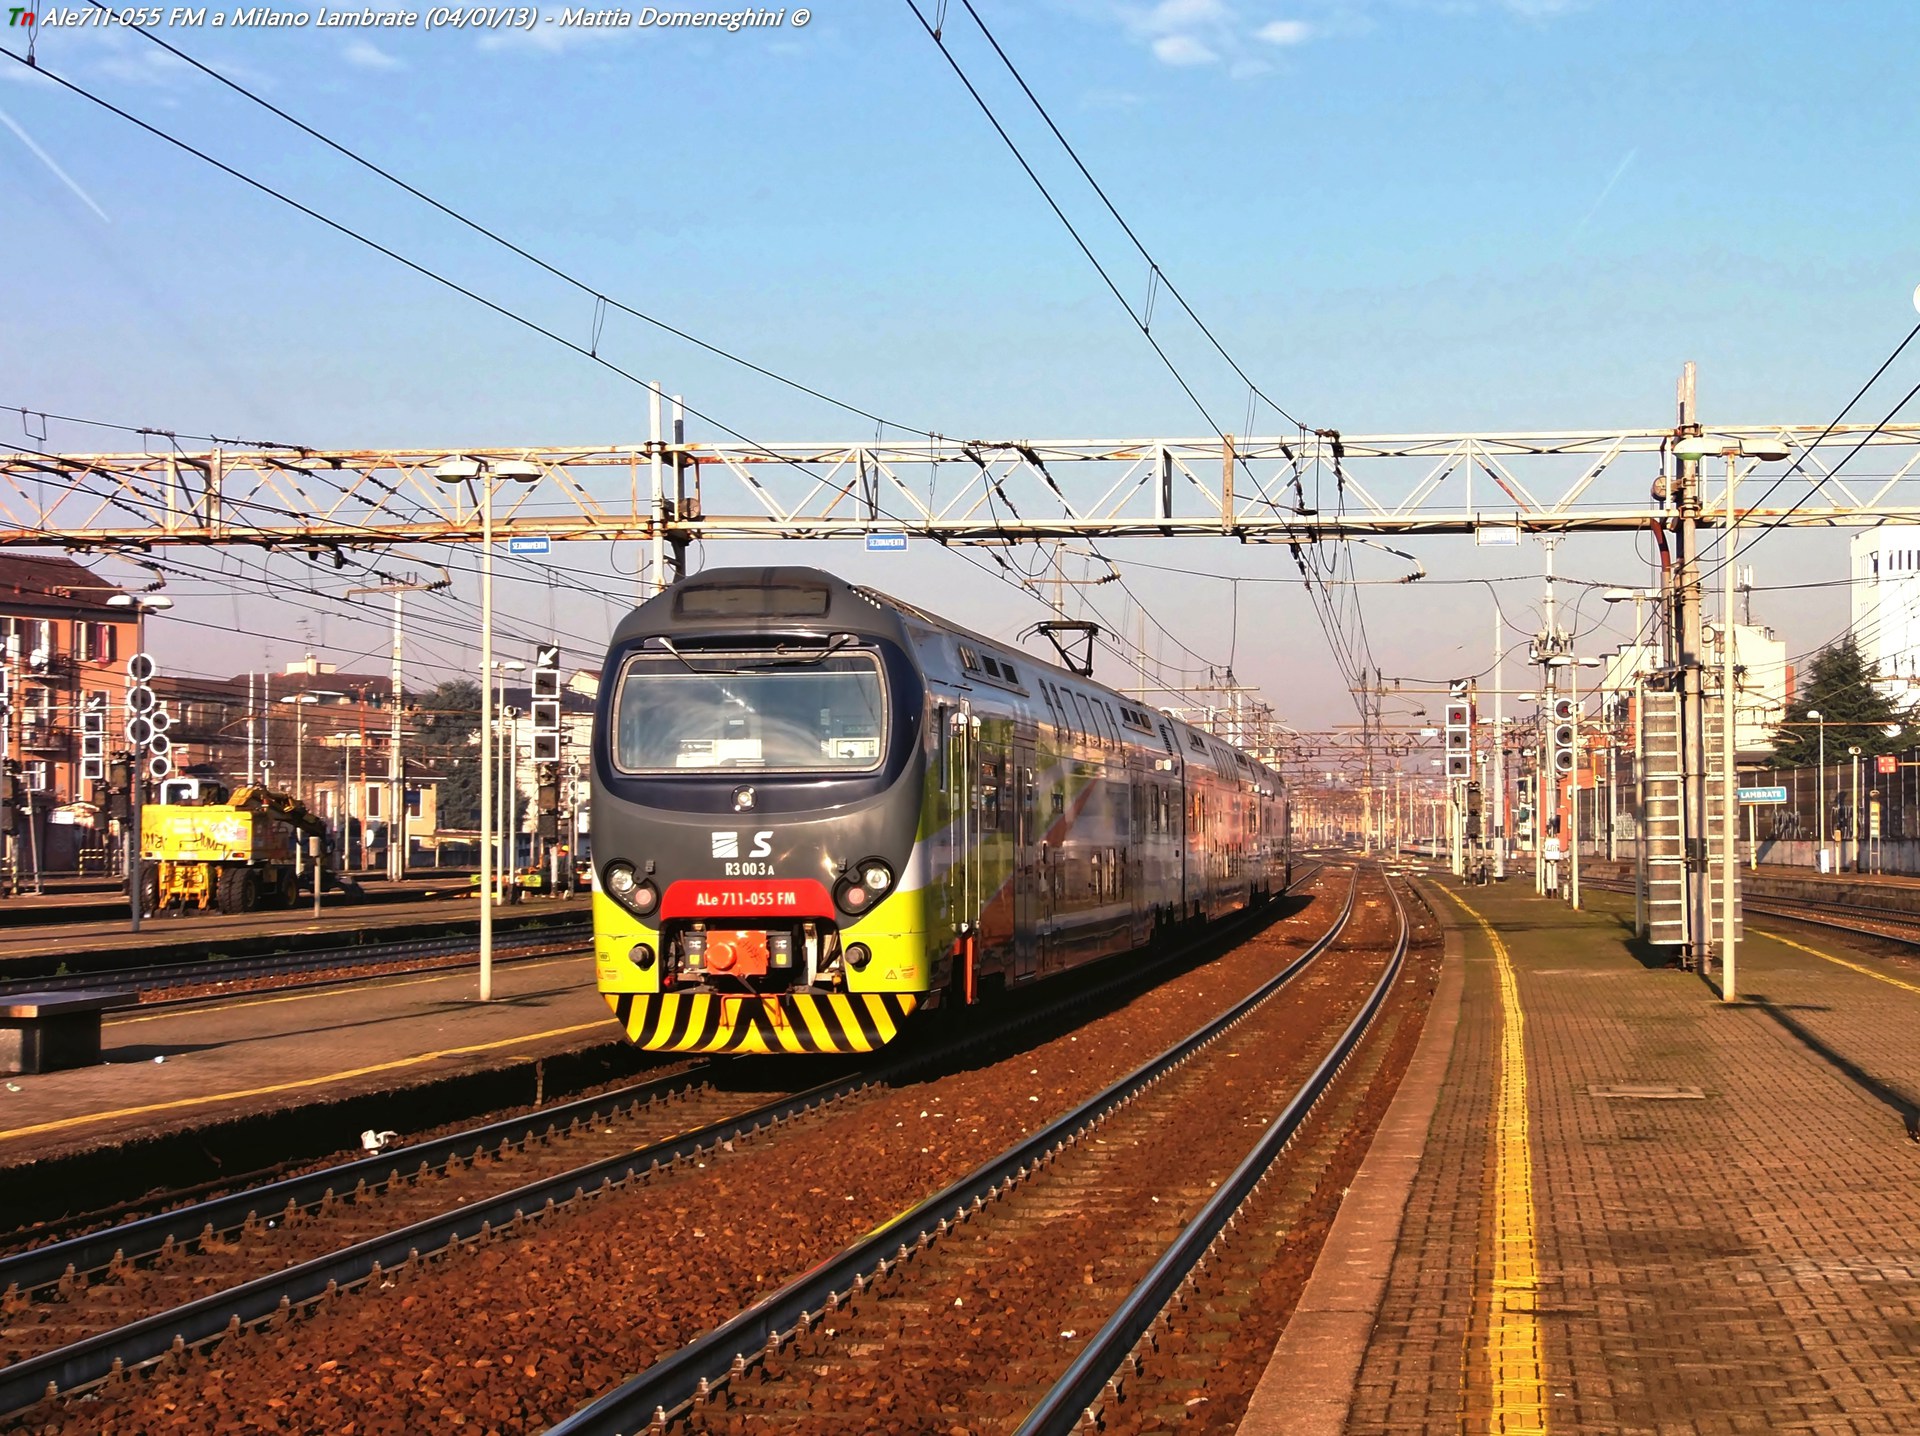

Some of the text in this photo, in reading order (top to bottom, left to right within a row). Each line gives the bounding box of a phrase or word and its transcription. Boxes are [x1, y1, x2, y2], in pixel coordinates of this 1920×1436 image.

[1740, 790, 1782, 799] LAMBRATE
[748, 831, 774, 858] S
[722, 892, 774, 906] 711-055
[777, 892, 796, 905] FM
